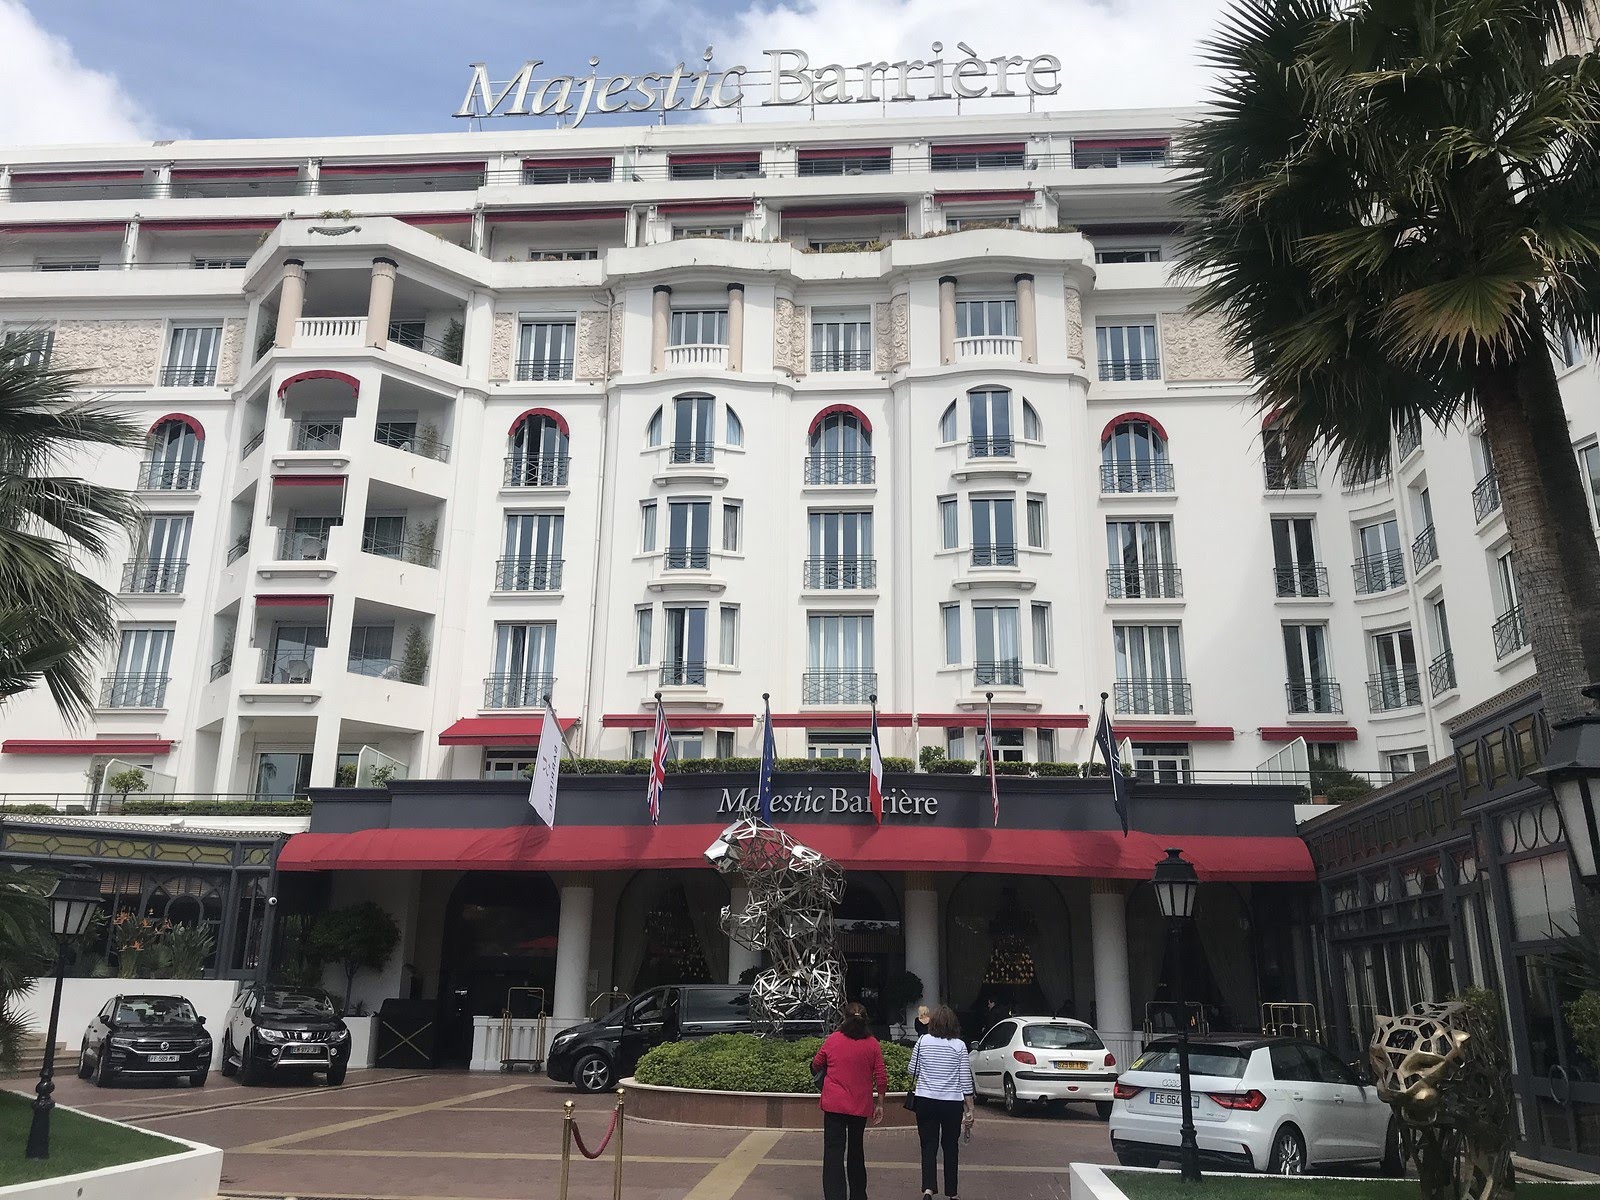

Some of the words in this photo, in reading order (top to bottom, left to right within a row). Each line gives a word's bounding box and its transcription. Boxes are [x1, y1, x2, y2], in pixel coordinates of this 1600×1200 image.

[451, 51, 747, 129] Majestic
[762, 40, 1062, 106] Barrière
[716, 787, 825, 813] Maestic
